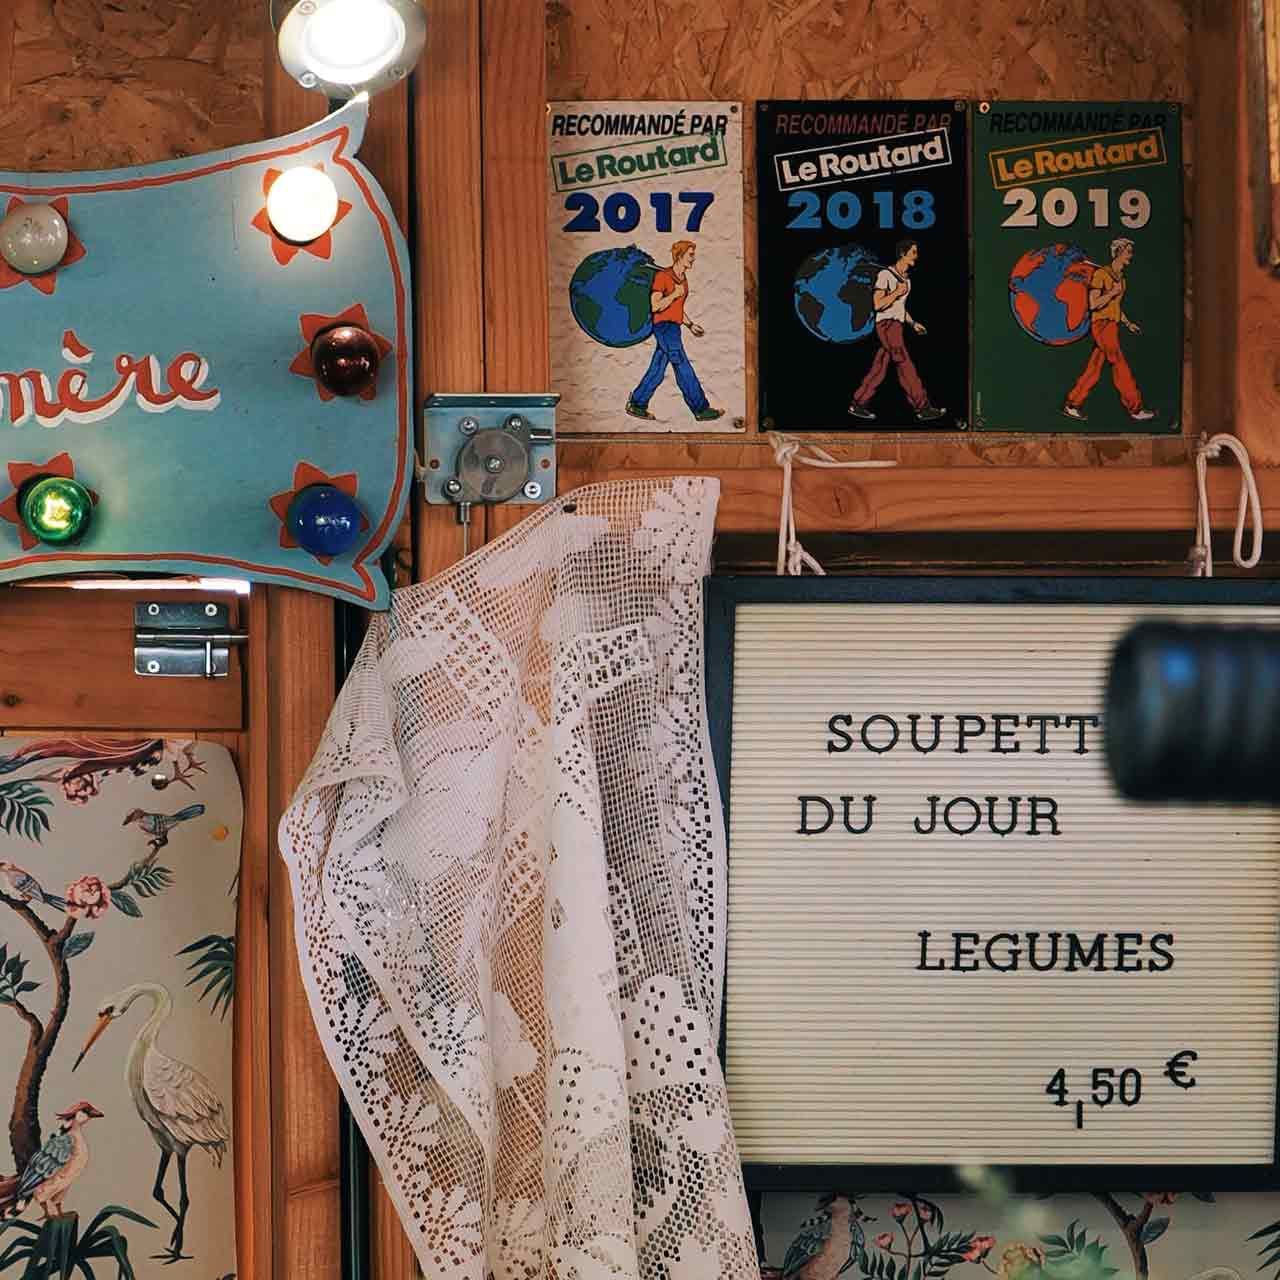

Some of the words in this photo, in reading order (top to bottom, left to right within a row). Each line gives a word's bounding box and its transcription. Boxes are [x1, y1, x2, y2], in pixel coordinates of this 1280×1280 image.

[552, 109, 686, 137] RECOMMANDÉ
[690, 115, 728, 137] PAR
[776, 106, 908, 135] RECOMMANDÉ
[912, 113, 951, 133] PAR
[990, 107, 1126, 134] RECOMMANDÉ
[1129, 112, 1167, 130] PAR
[558, 161, 594, 185] Le
[596, 137, 720, 178] Routard
[782, 160, 817, 184] Le
[819, 135, 944, 177] Routard
[997, 157, 1033, 182] Le
[1034, 134, 1158, 175] Routard
[562, 192, 715, 233] 2017
[785, 191, 936, 229] 2018
[1000, 187, 1151, 229] 2019
[827, 714, 1100, 754] SOUPETT
[797, 795, 877, 835] DU
[914, 795, 1063, 836] JOUR
[915, 930, 1176, 973] LEGUMES
[1163, 1050, 1198, 1091] €
